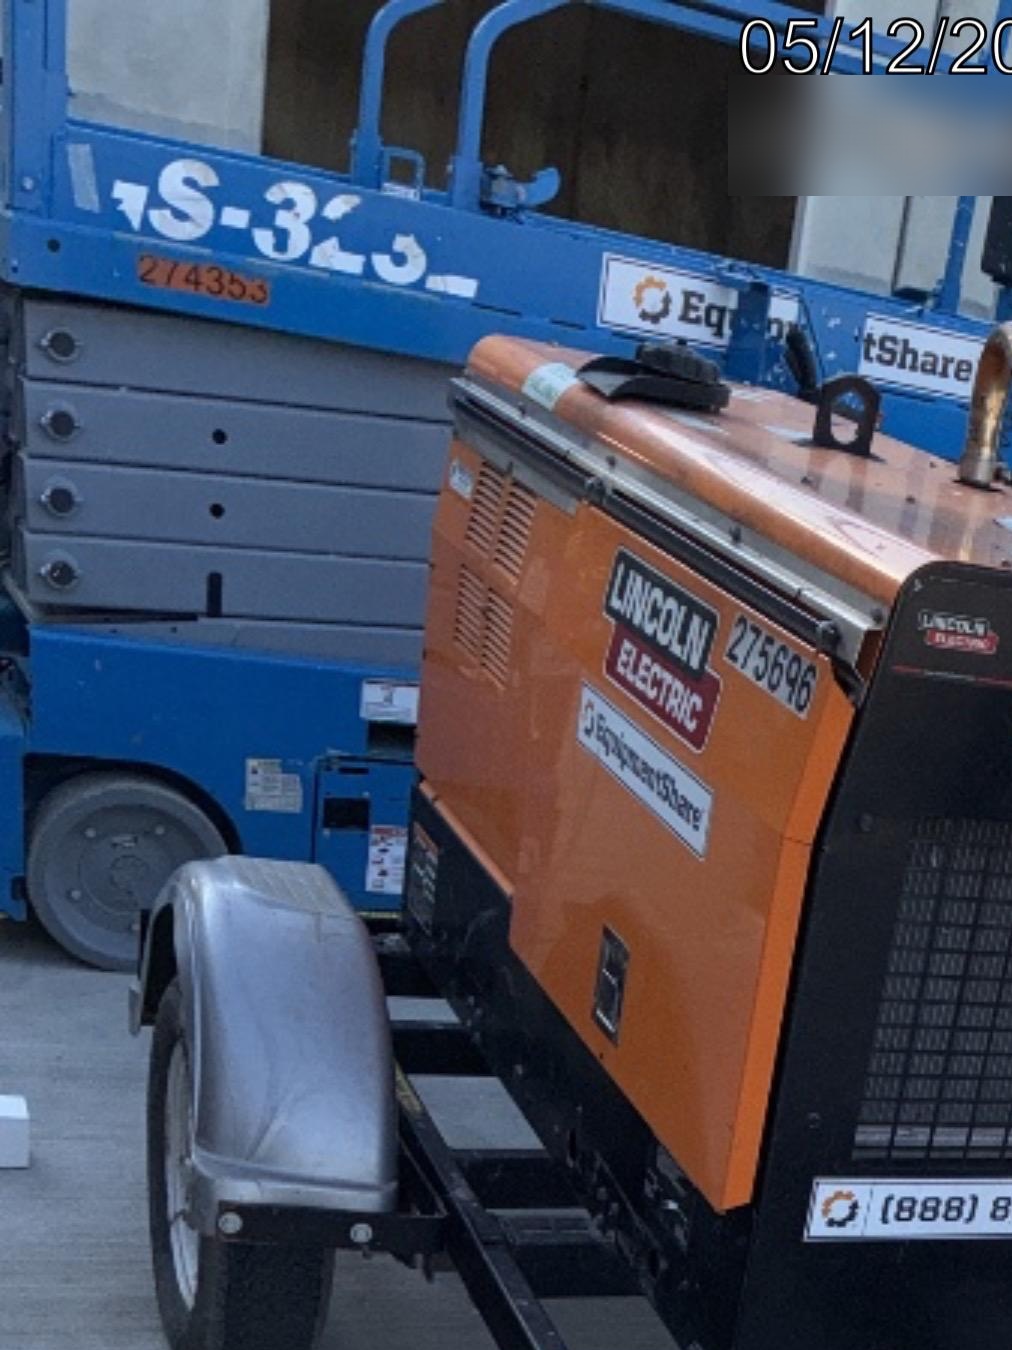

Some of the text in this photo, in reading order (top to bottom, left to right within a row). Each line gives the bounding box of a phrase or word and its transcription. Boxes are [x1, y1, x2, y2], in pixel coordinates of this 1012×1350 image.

[138, 254, 269, 304] 274353
[610, 562, 710, 671] LINCOLN
[616, 638, 704, 733] ELECTRIC
[726, 617, 817, 714] 275696
[595, 712, 703, 832] EquipmentShare
[880, 1193, 979, 1225] (888)
